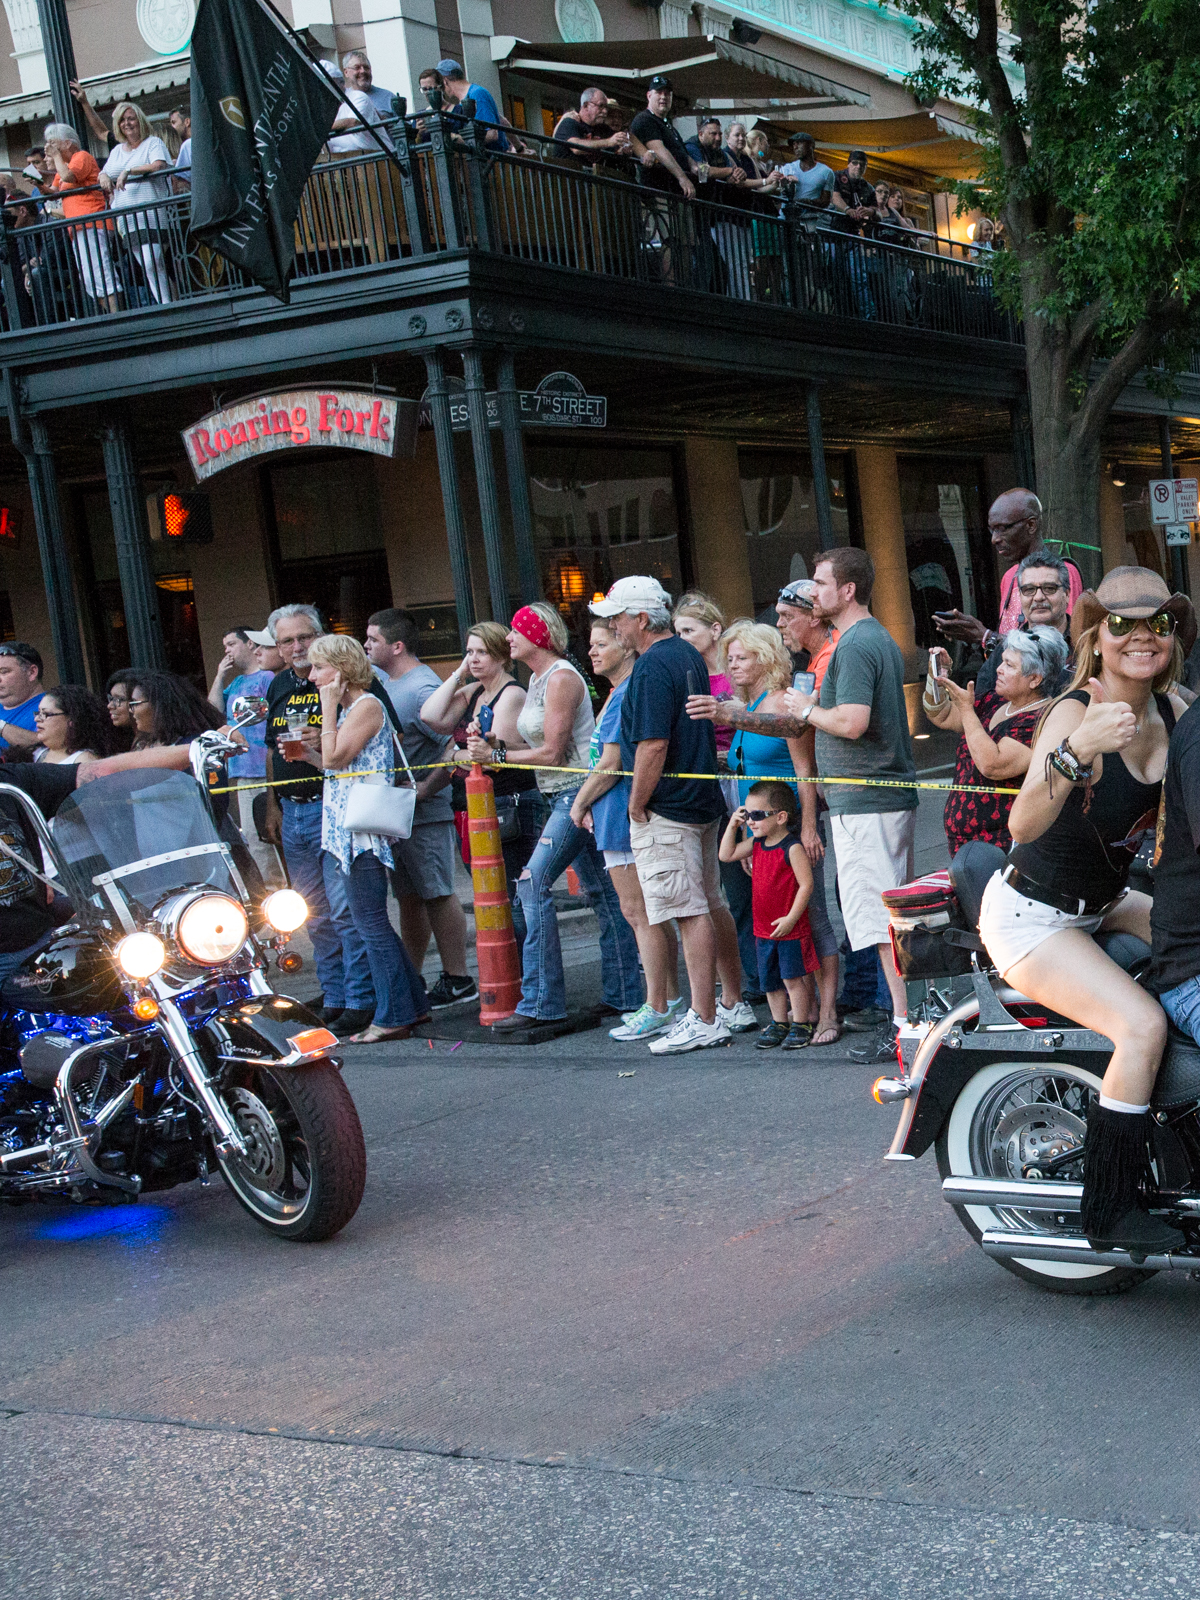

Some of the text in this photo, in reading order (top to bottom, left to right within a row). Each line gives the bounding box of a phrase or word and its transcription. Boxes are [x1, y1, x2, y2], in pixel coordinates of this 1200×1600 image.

[552, 397, 602, 416] STREET
[590, 416, 603, 424] 100
[189, 394, 390, 465] Roaring Fork
[287, 693, 319, 705] ABITA
